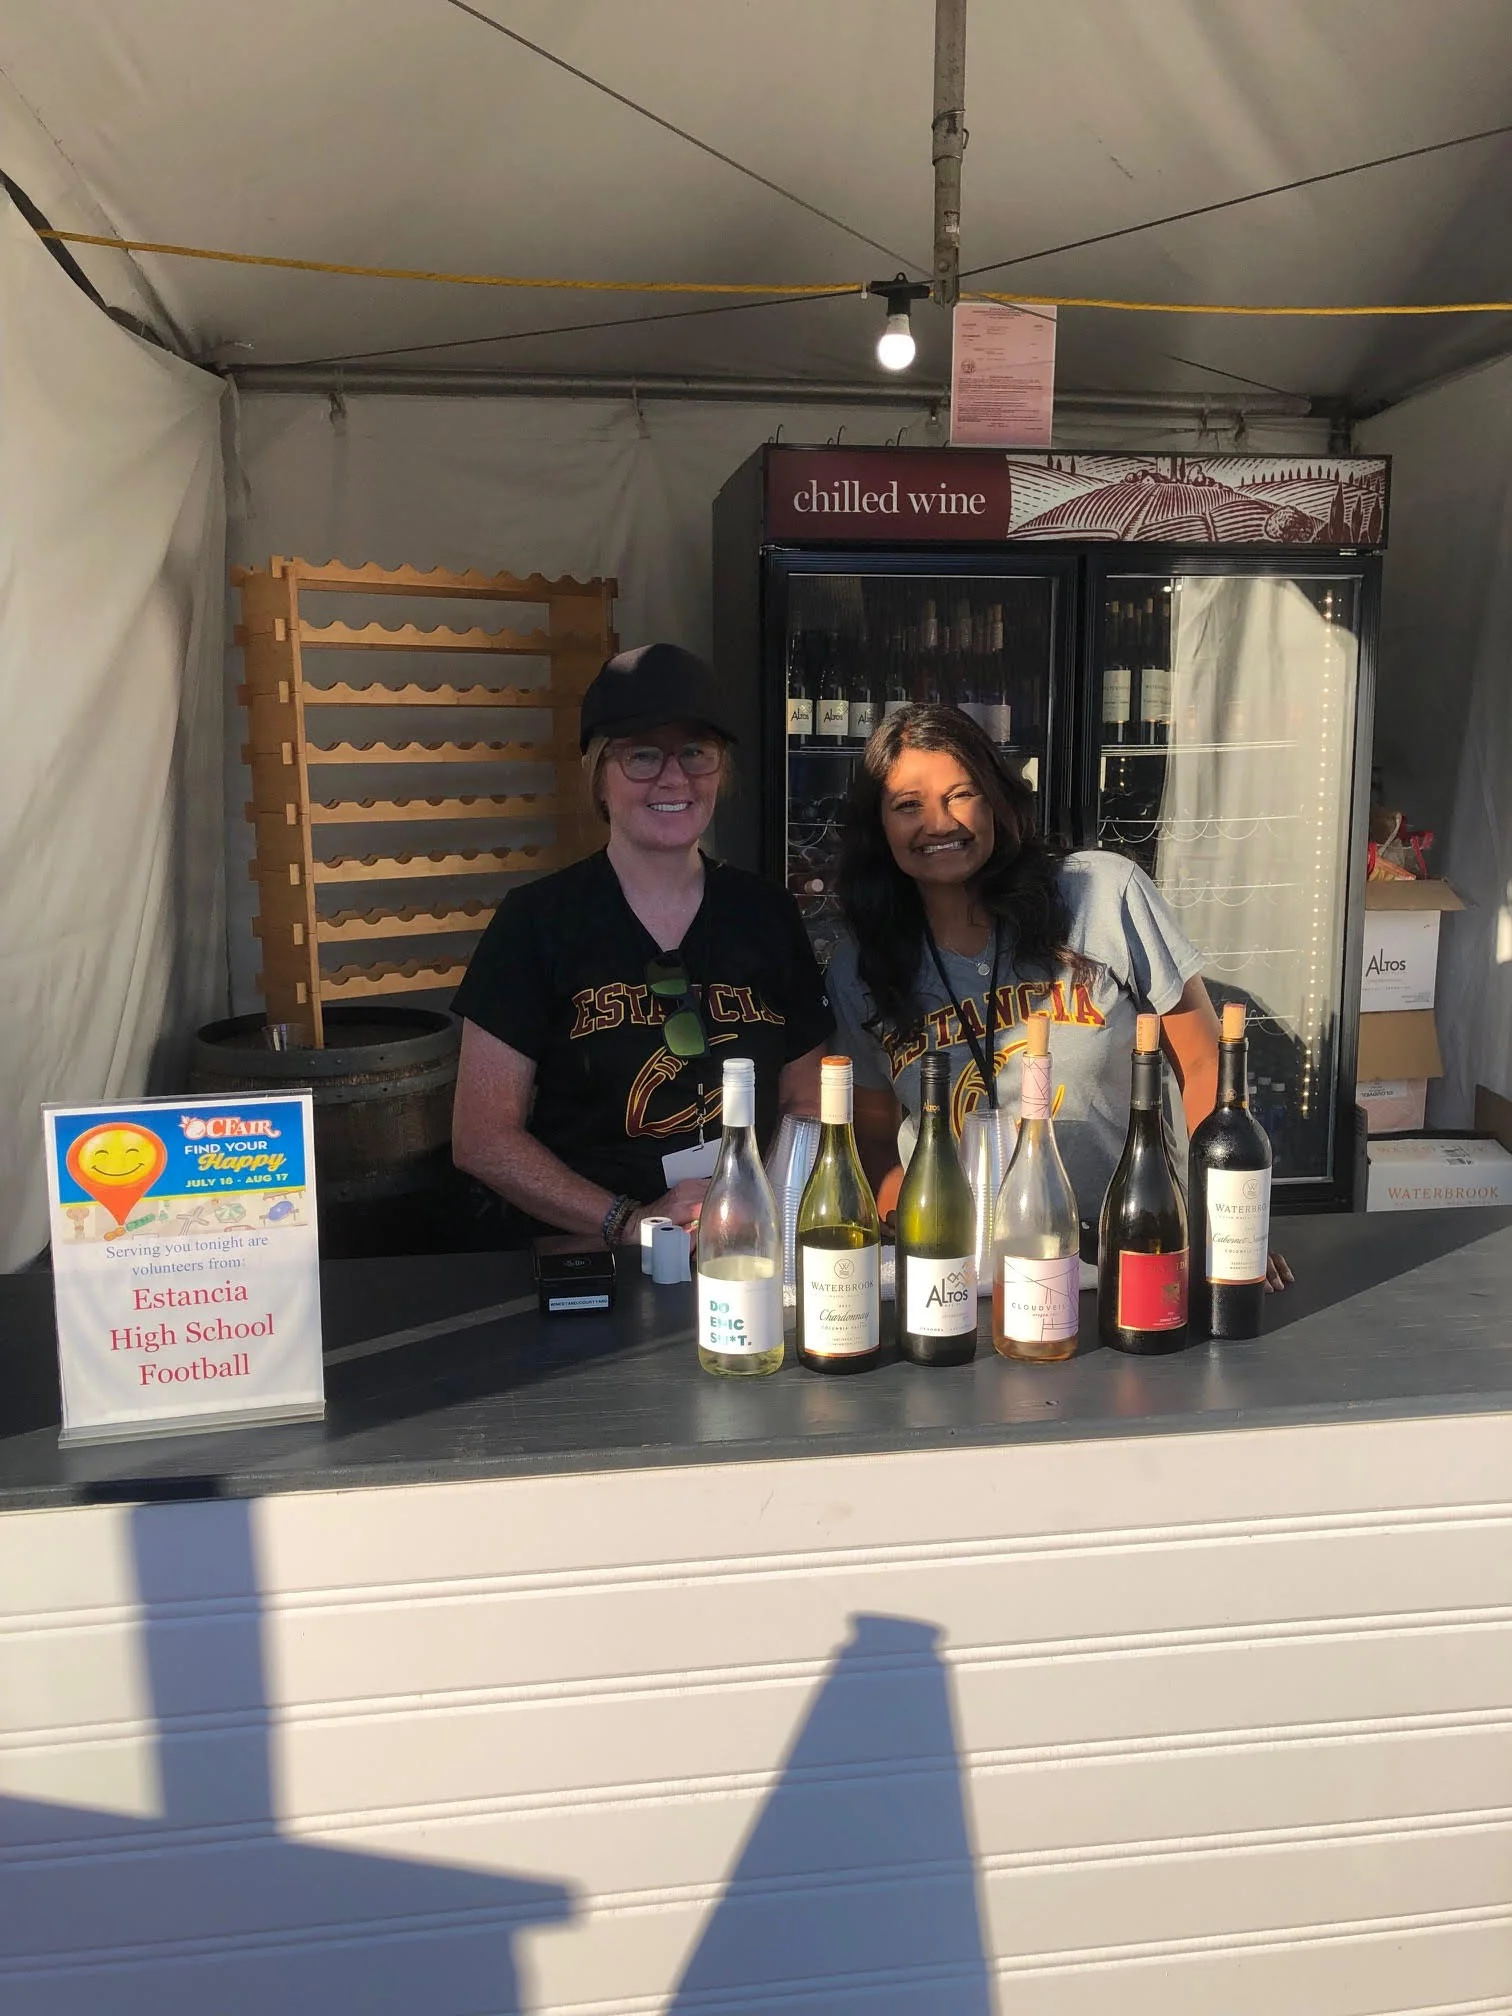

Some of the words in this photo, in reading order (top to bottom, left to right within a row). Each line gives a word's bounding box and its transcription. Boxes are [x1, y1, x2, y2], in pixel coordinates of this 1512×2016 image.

[794, 480, 900, 513] chilled
[907, 483, 986, 514] wine
[570, 983, 785, 1039] ESTACI
[184, 1143, 221, 1155] FIND
[225, 1140, 268, 1152] YOUR
[198, 1152, 287, 1172] Happy
[186, 1178, 216, 1188] JULY
[220, 1177, 234, 1186] 18
[245, 1175, 272, 1184] AUG
[276, 1173, 289, 1182] 17
[1388, 1186, 1499, 1200] WATERBROOK
[106, 1244, 160, 1259] Serving
[165, 1243, 191, 1256] you
[195, 1237, 244, 1252] tonight
[248, 1236, 269, 1247] are
[132, 1262, 204, 1276] volunteers
[133, 1280, 248, 1311] Estancia
[811, 1280, 874, 1292] WATERBROOK
[710, 1300, 730, 1313] DO
[110, 1323, 177, 1353] High
[186, 1314, 276, 1343] School
[139, 1353, 251, 1386] Football
